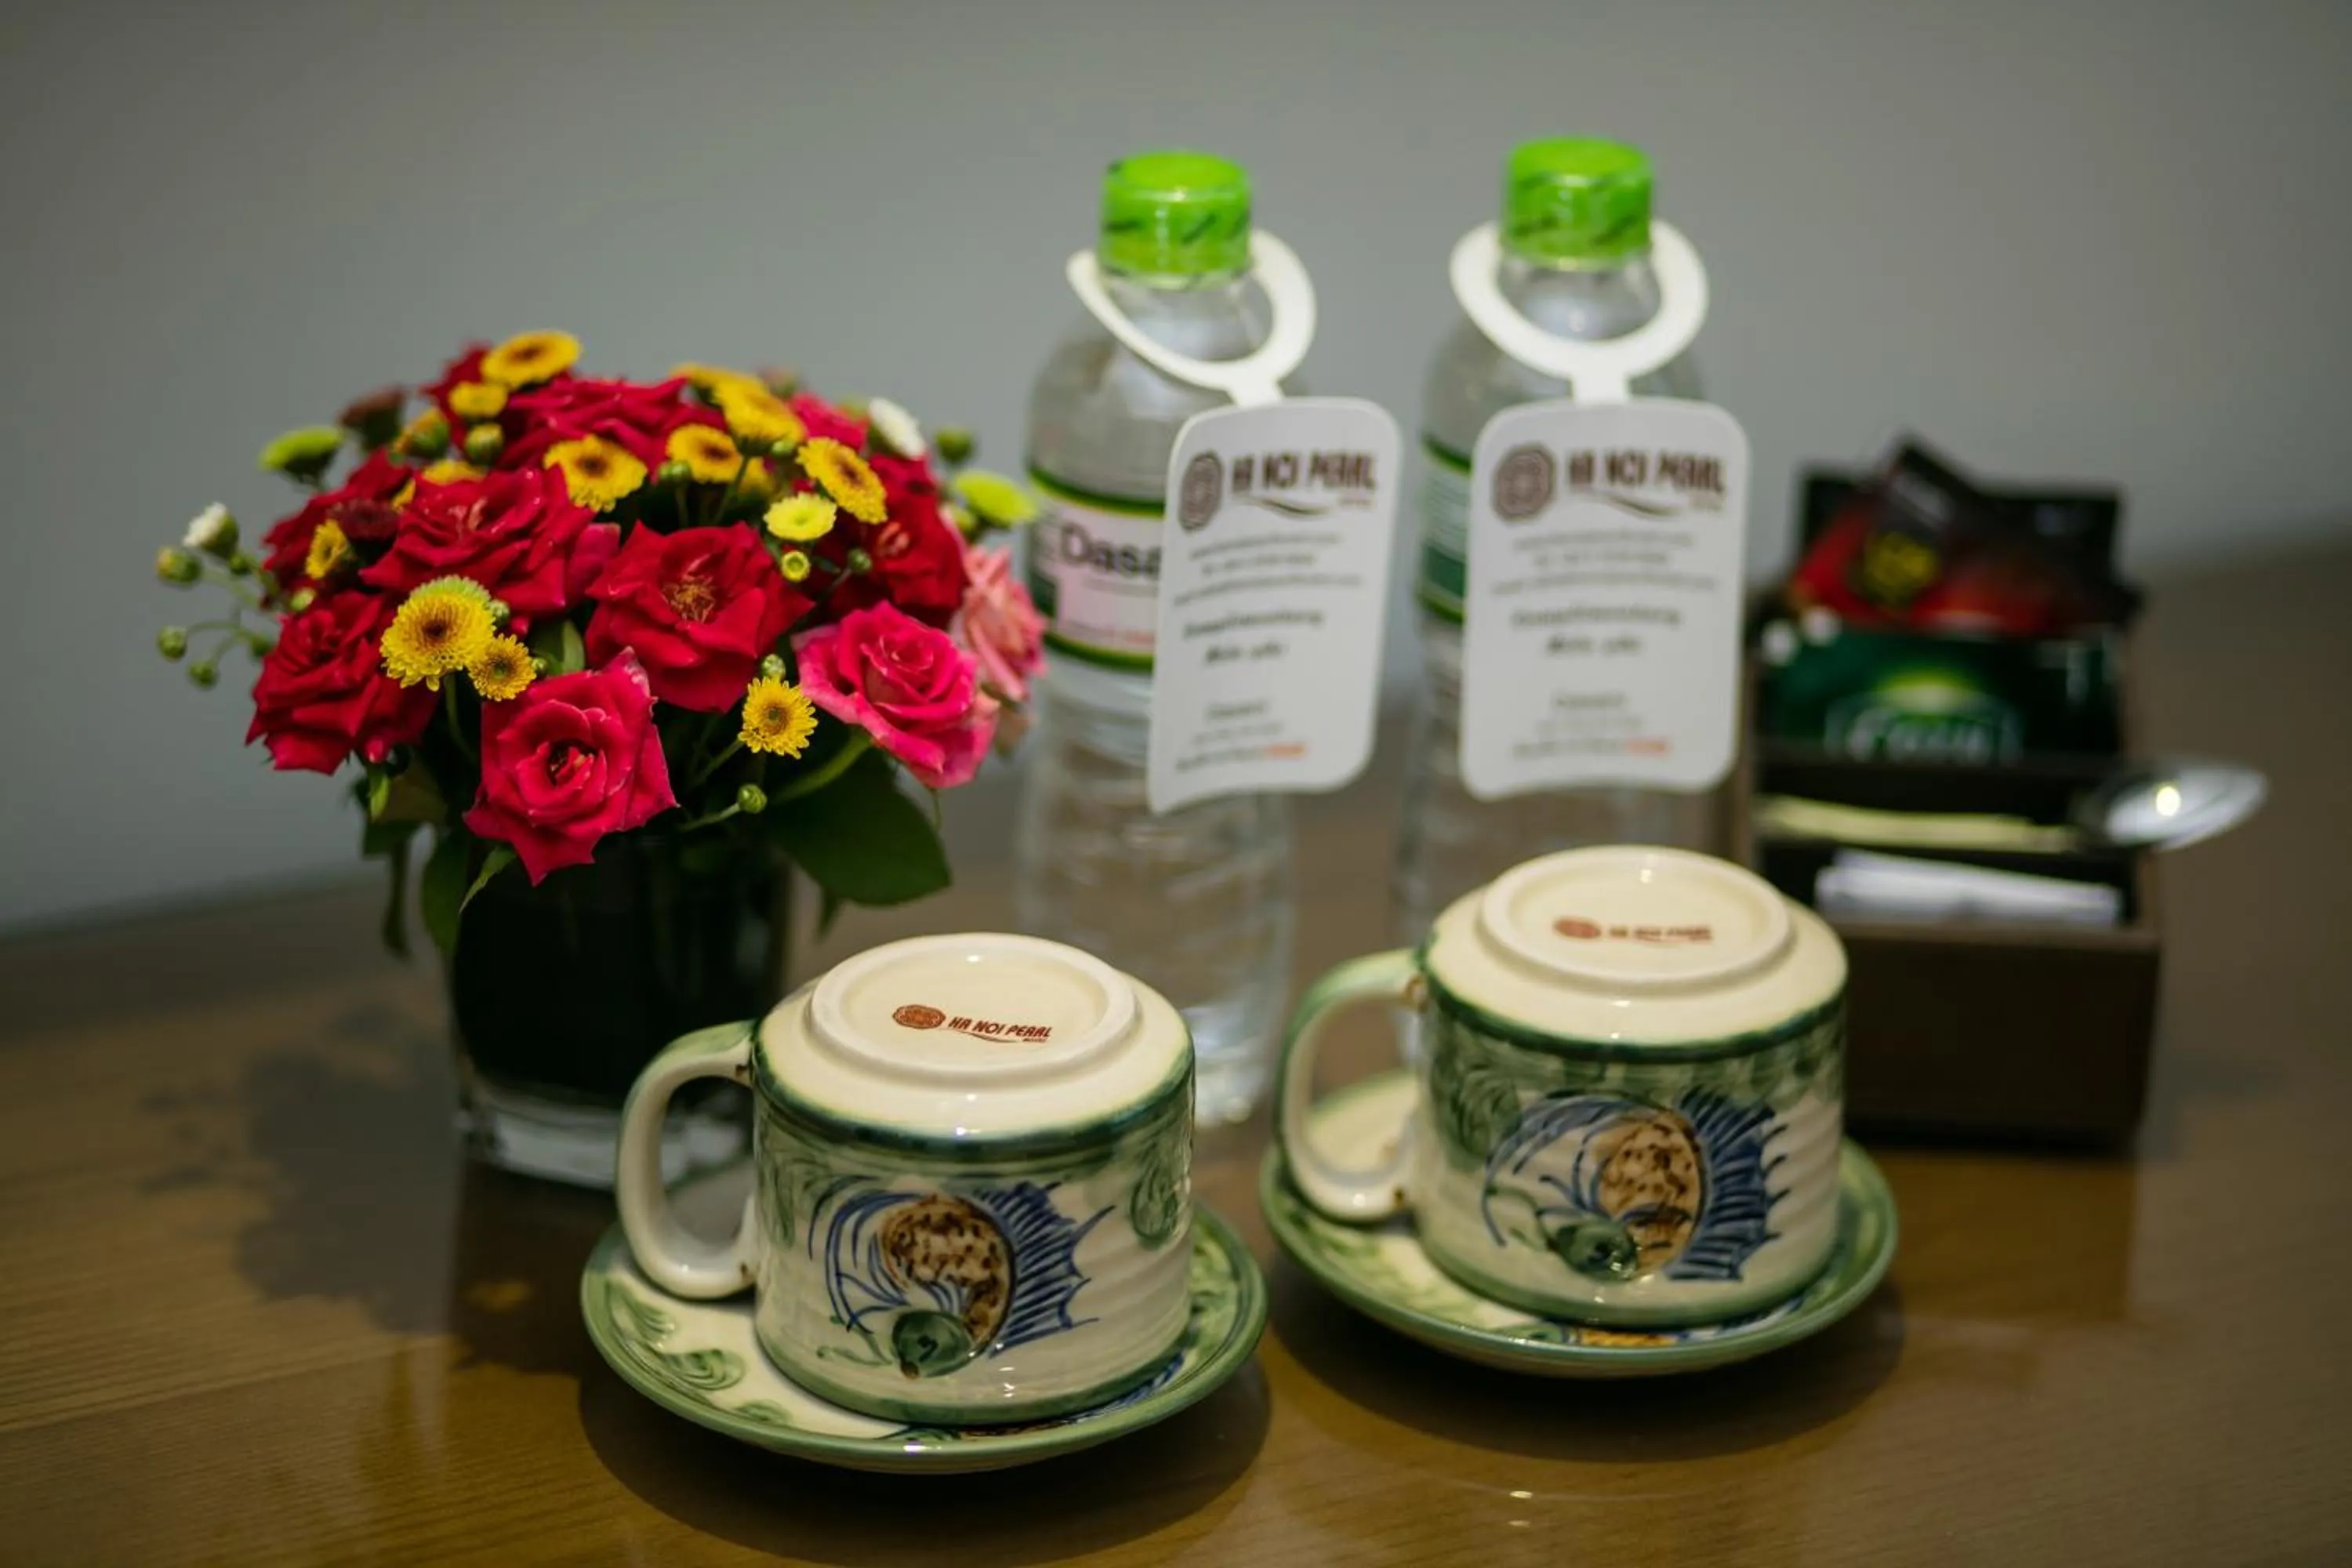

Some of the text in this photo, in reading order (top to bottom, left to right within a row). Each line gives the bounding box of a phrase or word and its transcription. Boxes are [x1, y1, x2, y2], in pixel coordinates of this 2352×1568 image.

[948, 1017, 1052, 1037] HA NOI PEARL
